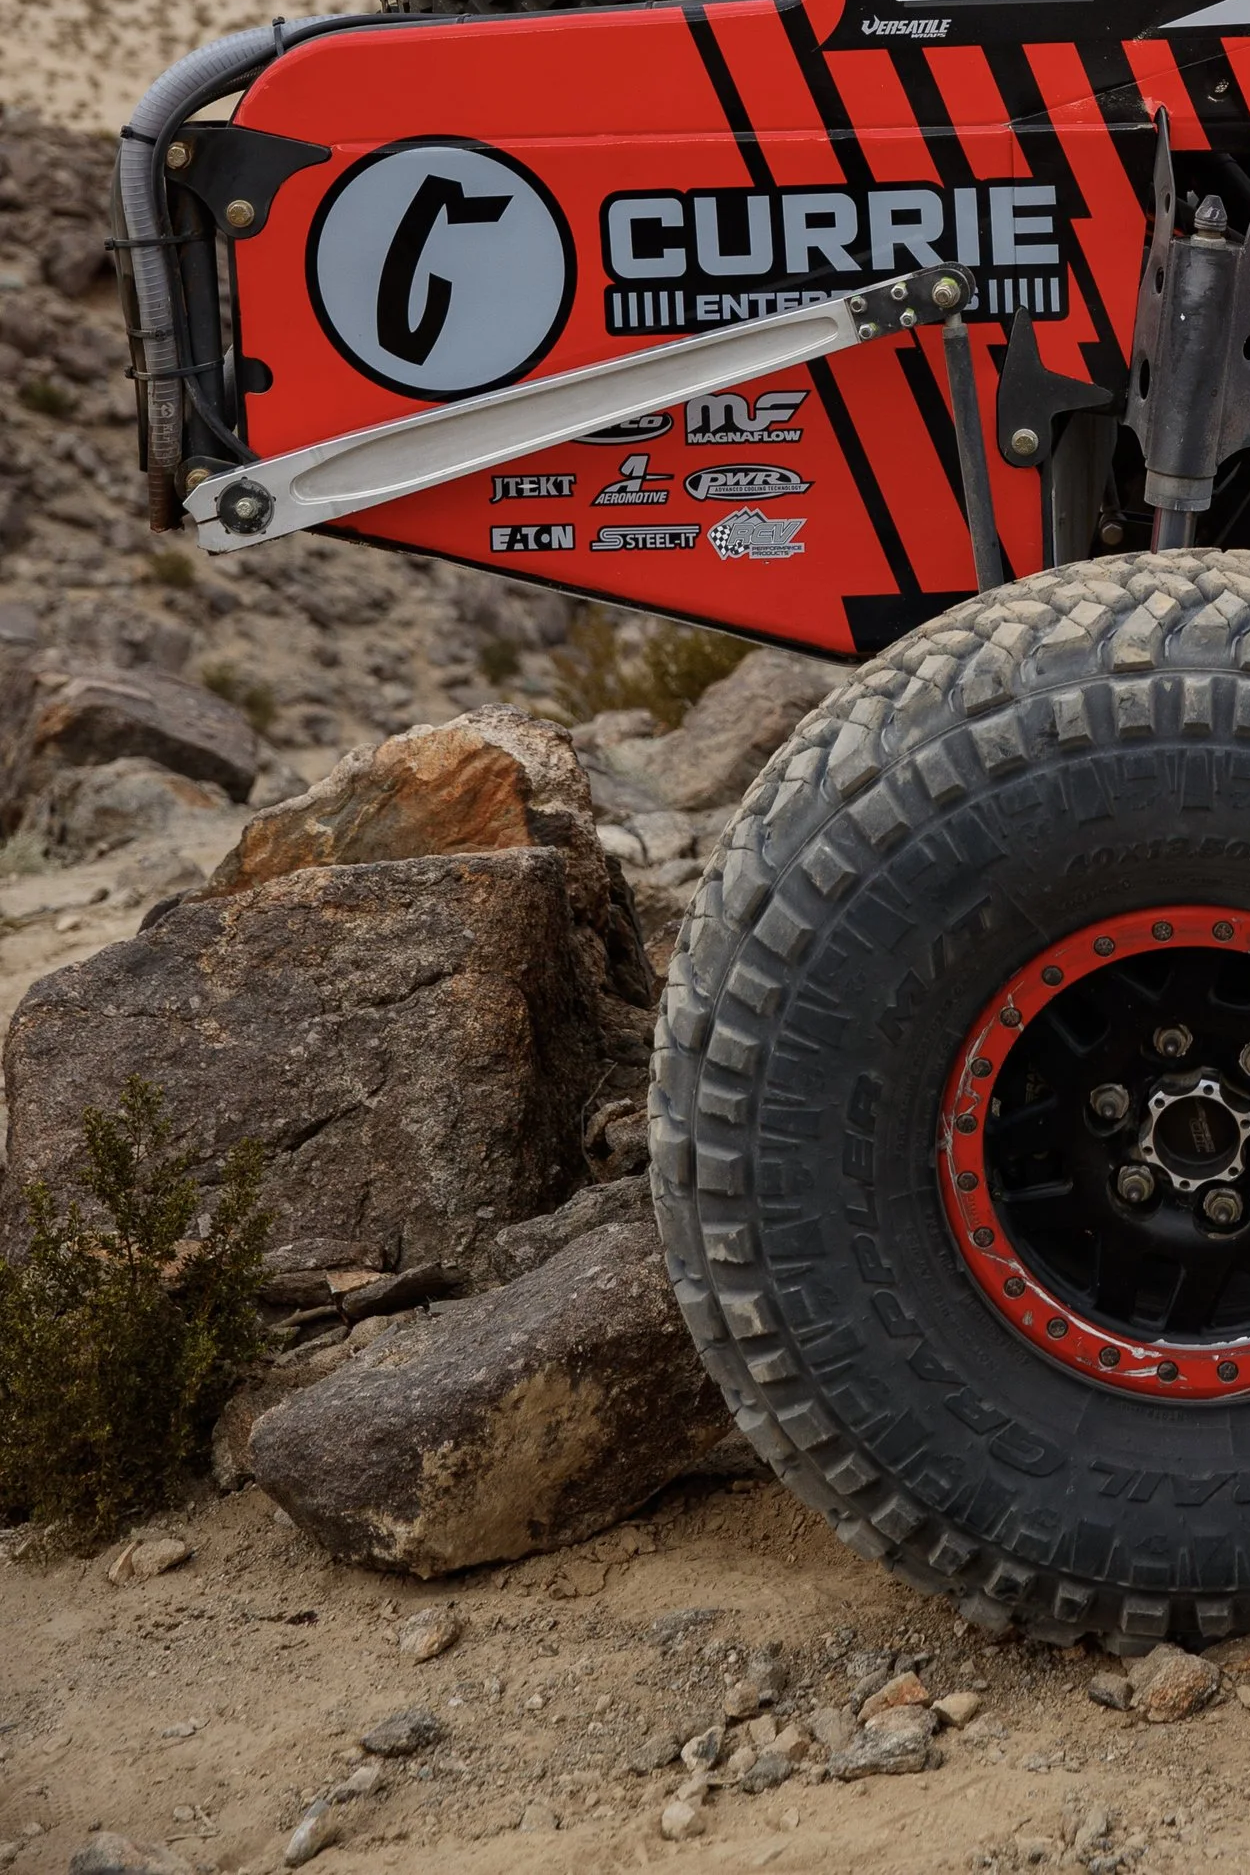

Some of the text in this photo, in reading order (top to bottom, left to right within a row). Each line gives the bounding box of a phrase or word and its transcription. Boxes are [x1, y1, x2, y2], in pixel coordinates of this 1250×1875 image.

[861, 14, 952, 35] VERSATILE
[608, 185, 1060, 279] CURRIE
[687, 430, 801, 444] MAGNAFLOW
[492, 476, 575, 502] JTEKT
[697, 472, 786, 499] PWR
[595, 491, 668, 505] AEROMOTIVE
[492, 525, 573, 550] EATON
[625, 533, 697, 549] STEEL-IT
[727, 521, 802, 545] RCV
[845, 1069, 1068, 1480] GRAPPLER
